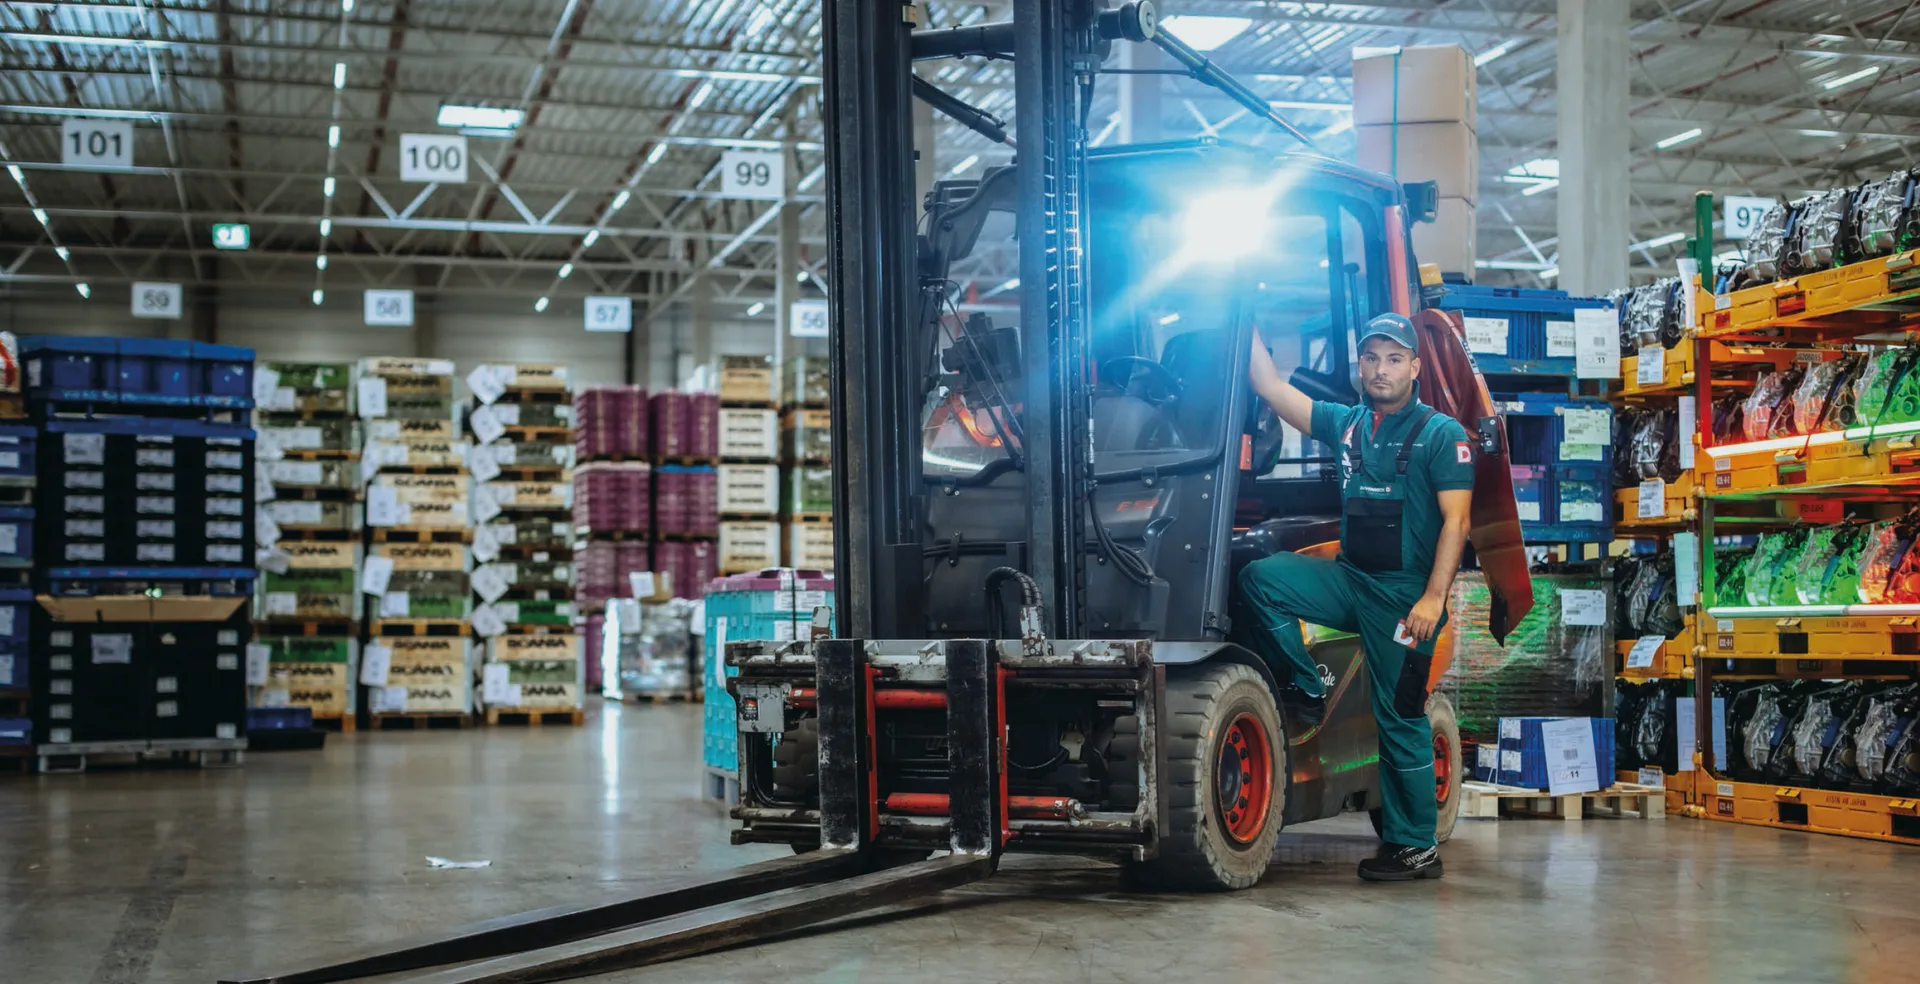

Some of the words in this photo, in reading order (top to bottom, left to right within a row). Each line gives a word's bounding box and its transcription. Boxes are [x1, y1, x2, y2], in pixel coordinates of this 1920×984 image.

[68, 130, 123, 157] 101
[406, 145, 461, 171] 100
[735, 161, 770, 186] 99
[1737, 206, 1764, 228] 97
[141, 289, 170, 311] 59
[596, 305, 620, 324] 57
[1597, 356, 1605, 364] 11
[1456, 445, 1472, 463] D
[1570, 770, 1579, 778] 11
